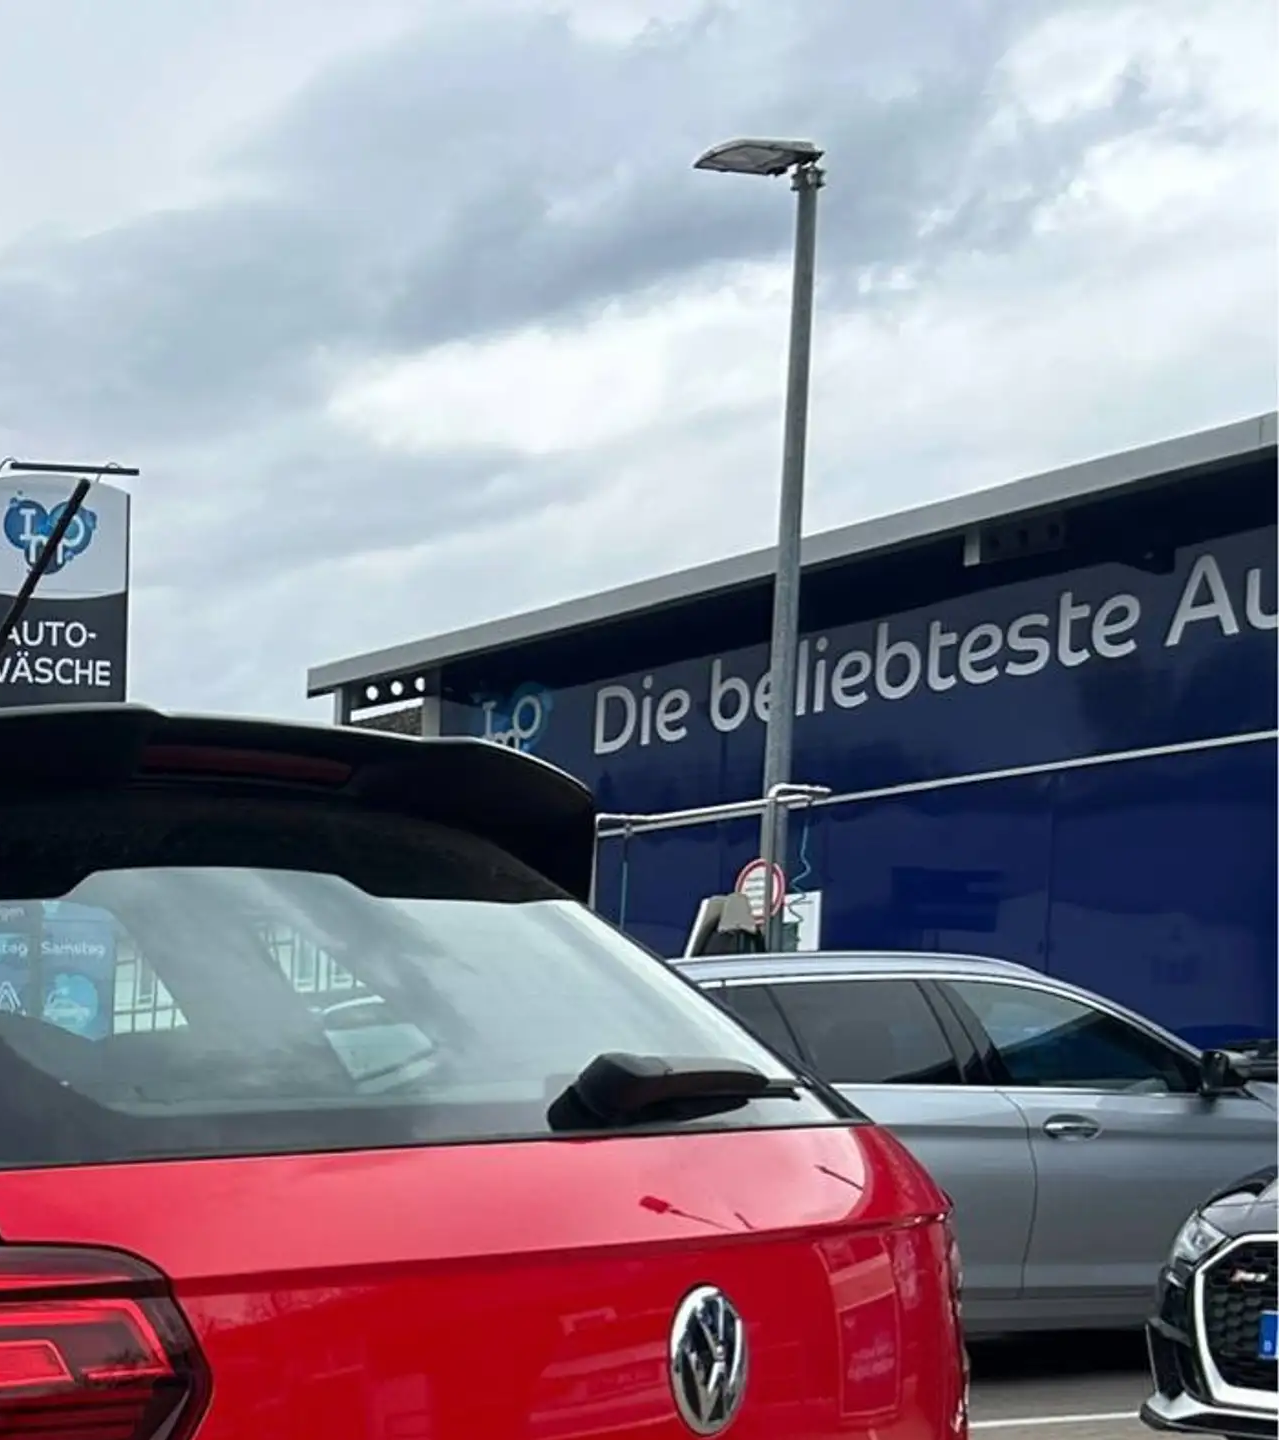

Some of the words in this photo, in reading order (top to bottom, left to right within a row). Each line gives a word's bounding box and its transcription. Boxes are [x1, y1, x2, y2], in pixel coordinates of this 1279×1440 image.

[8, 619, 97, 648] AUTO-
[594, 675, 691, 755] Die
[710, 592, 1141, 733] beliebteste
